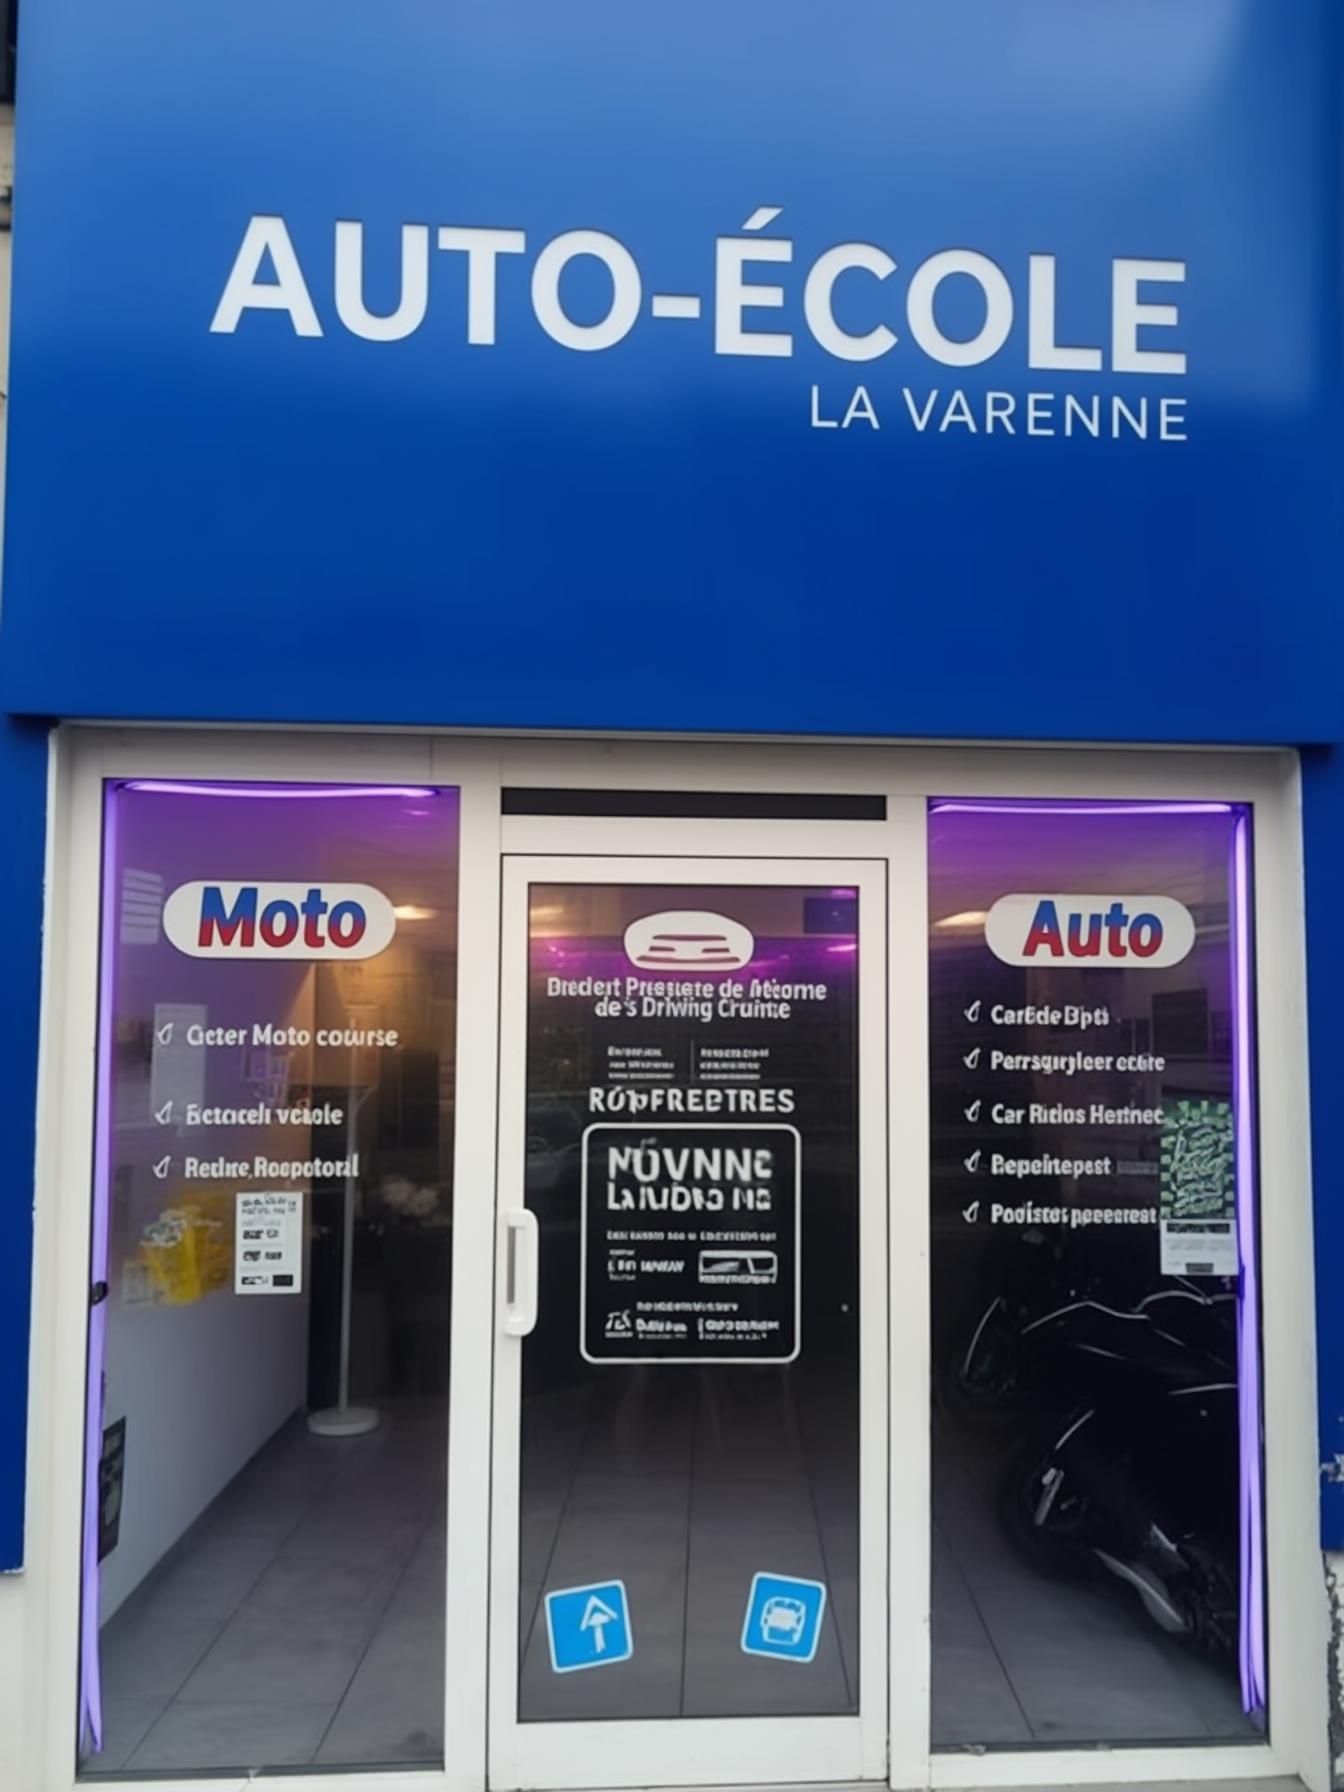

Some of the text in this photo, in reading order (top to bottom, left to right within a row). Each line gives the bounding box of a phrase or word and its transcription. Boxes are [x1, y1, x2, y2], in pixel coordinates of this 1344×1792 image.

[209, 206, 1188, 375] AUTO-ÉCOLE
[811, 384, 1189, 441] LA VARENNE
[198, 885, 367, 948] Moto
[1022, 899, 1164, 958] Auto
[252, 1023, 311, 1047] Moto
[991, 1103, 1025, 1125] Car
